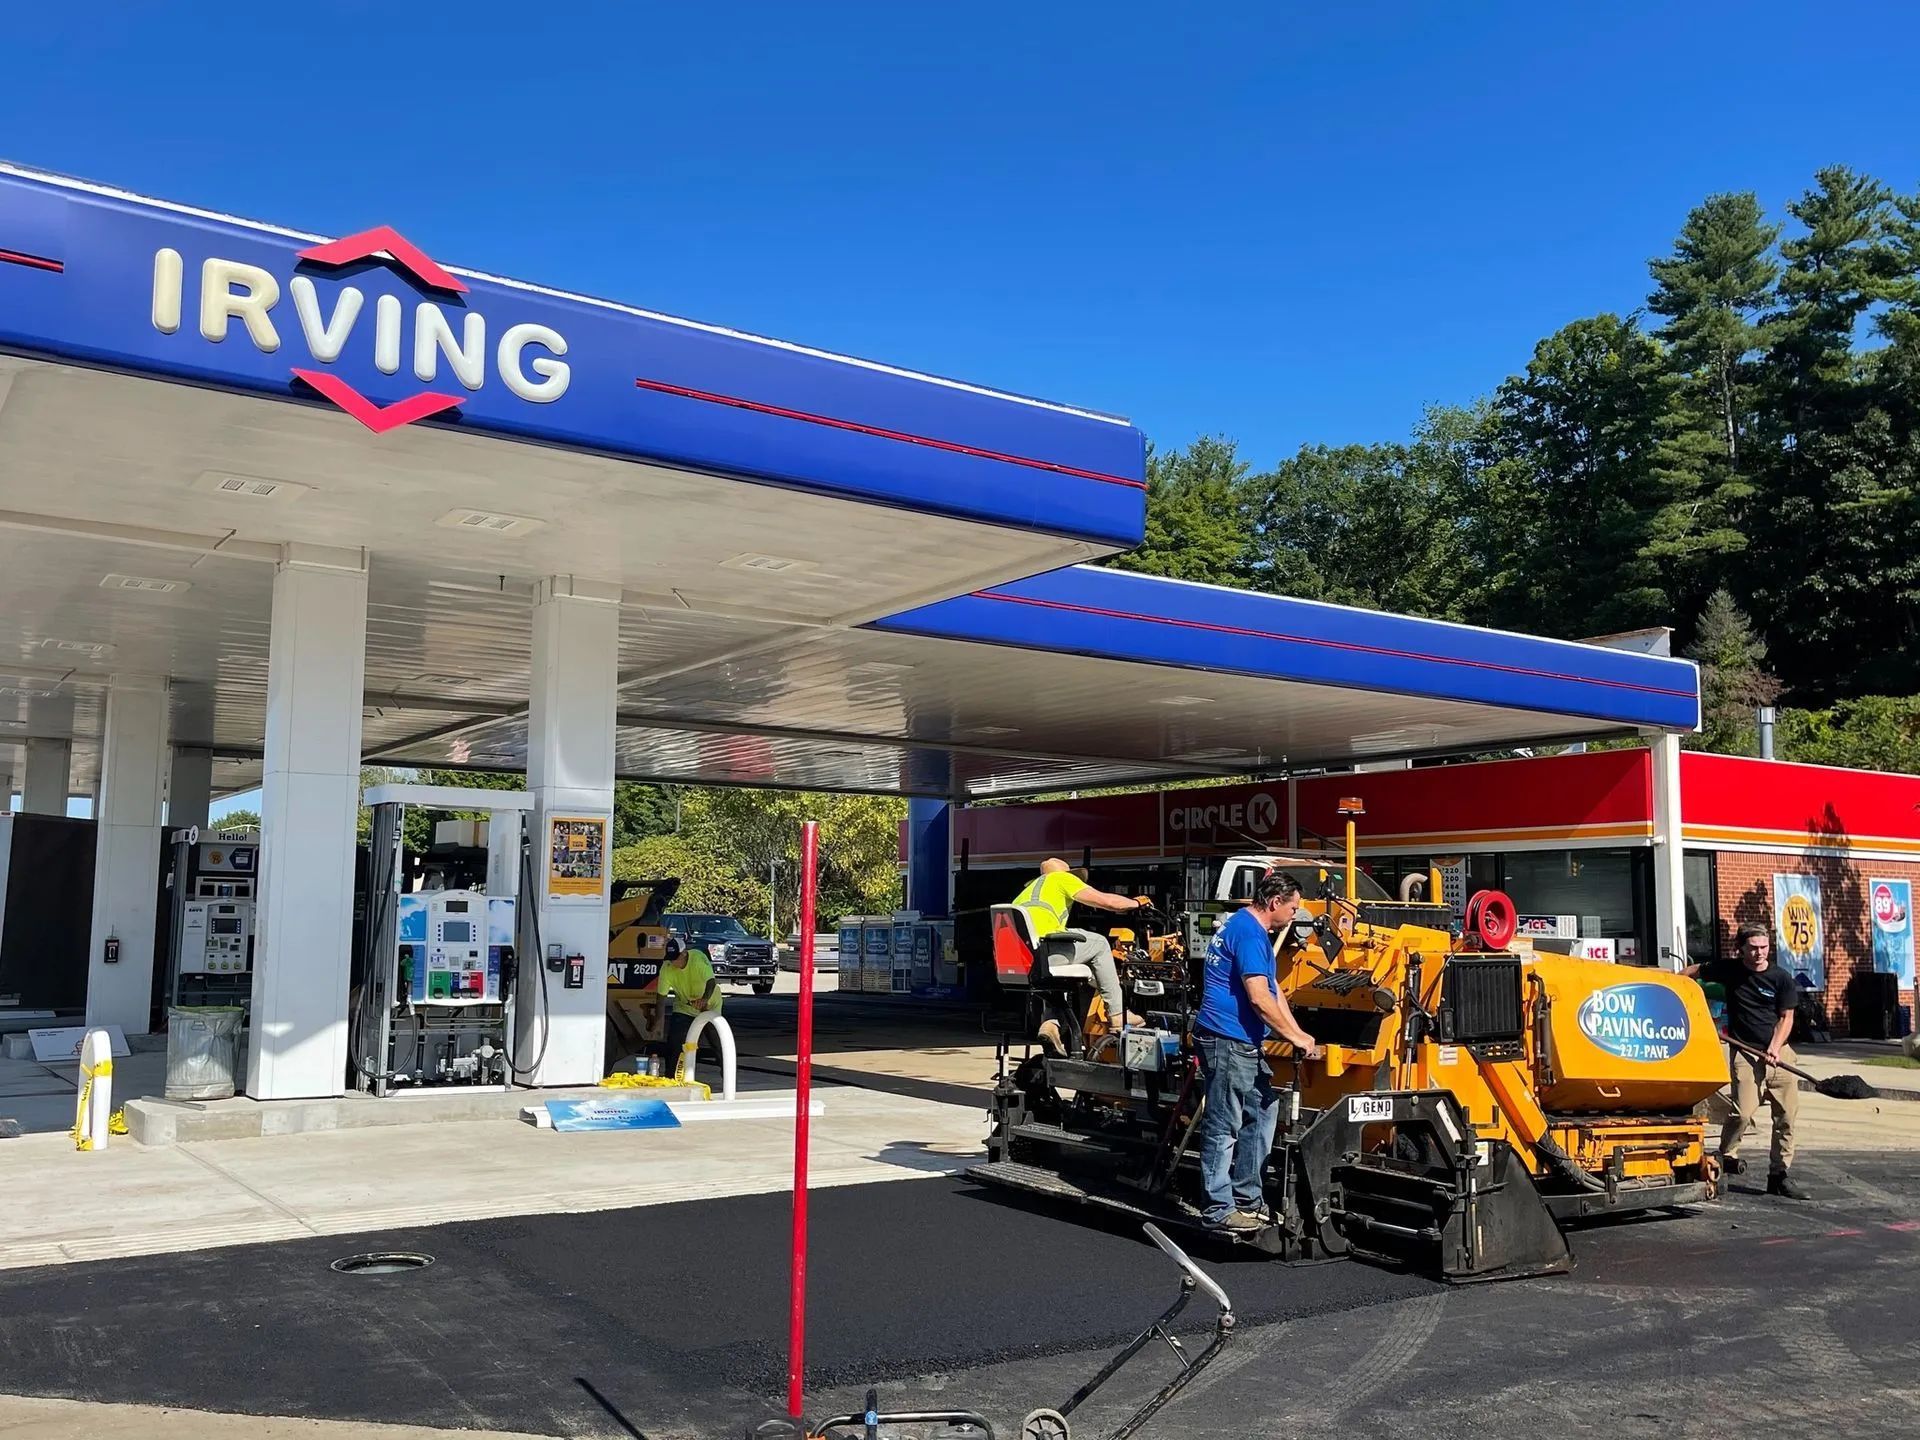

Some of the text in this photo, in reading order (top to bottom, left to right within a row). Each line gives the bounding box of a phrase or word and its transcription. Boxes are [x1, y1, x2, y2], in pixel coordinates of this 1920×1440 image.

[152, 248, 570, 402] IRVING
[1169, 804, 1243, 830] CIRCLE
[191, 829, 196, 841] 6
[218, 833, 248, 841] Hello!
[1788, 906, 1809, 920] WIN
[1528, 920, 1547, 930] ICE
[1590, 947, 1608, 959] ICE
[607, 963, 657, 984] AT 262D
[1592, 989, 1636, 1014] BOW
[1590, 1013, 1686, 1040] PAVING.COM
[1620, 1044, 1670, 1059] 227-PAVE
